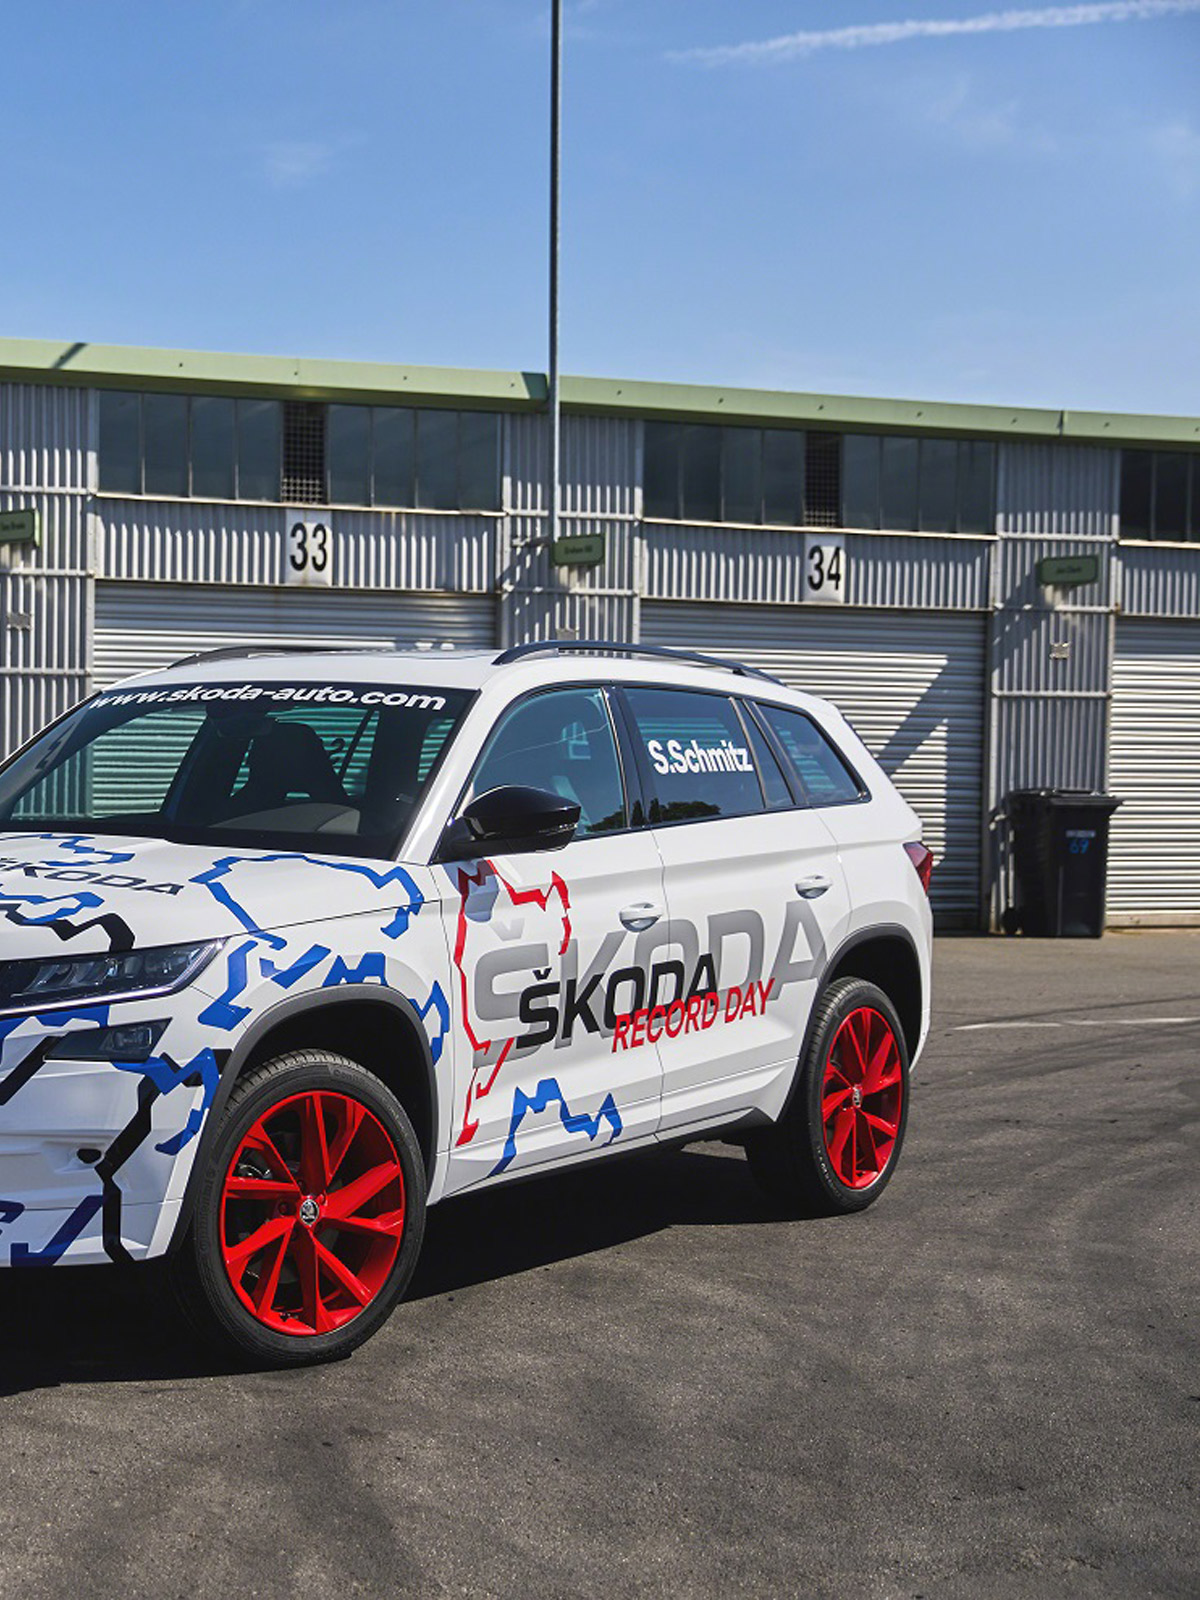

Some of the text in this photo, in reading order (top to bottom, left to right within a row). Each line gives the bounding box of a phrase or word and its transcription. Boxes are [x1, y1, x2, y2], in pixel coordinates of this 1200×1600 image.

[289, 522, 328, 573] 33
[807, 545, 842, 592] 34
[89, 684, 448, 712] www.skoda-auto.com
[647, 739, 755, 775] S.Schmitz
[473, 899, 829, 1070] ŠKODA
[516, 952, 722, 1050] ŠKODA
[611, 977, 777, 1054] RECORD DAY
